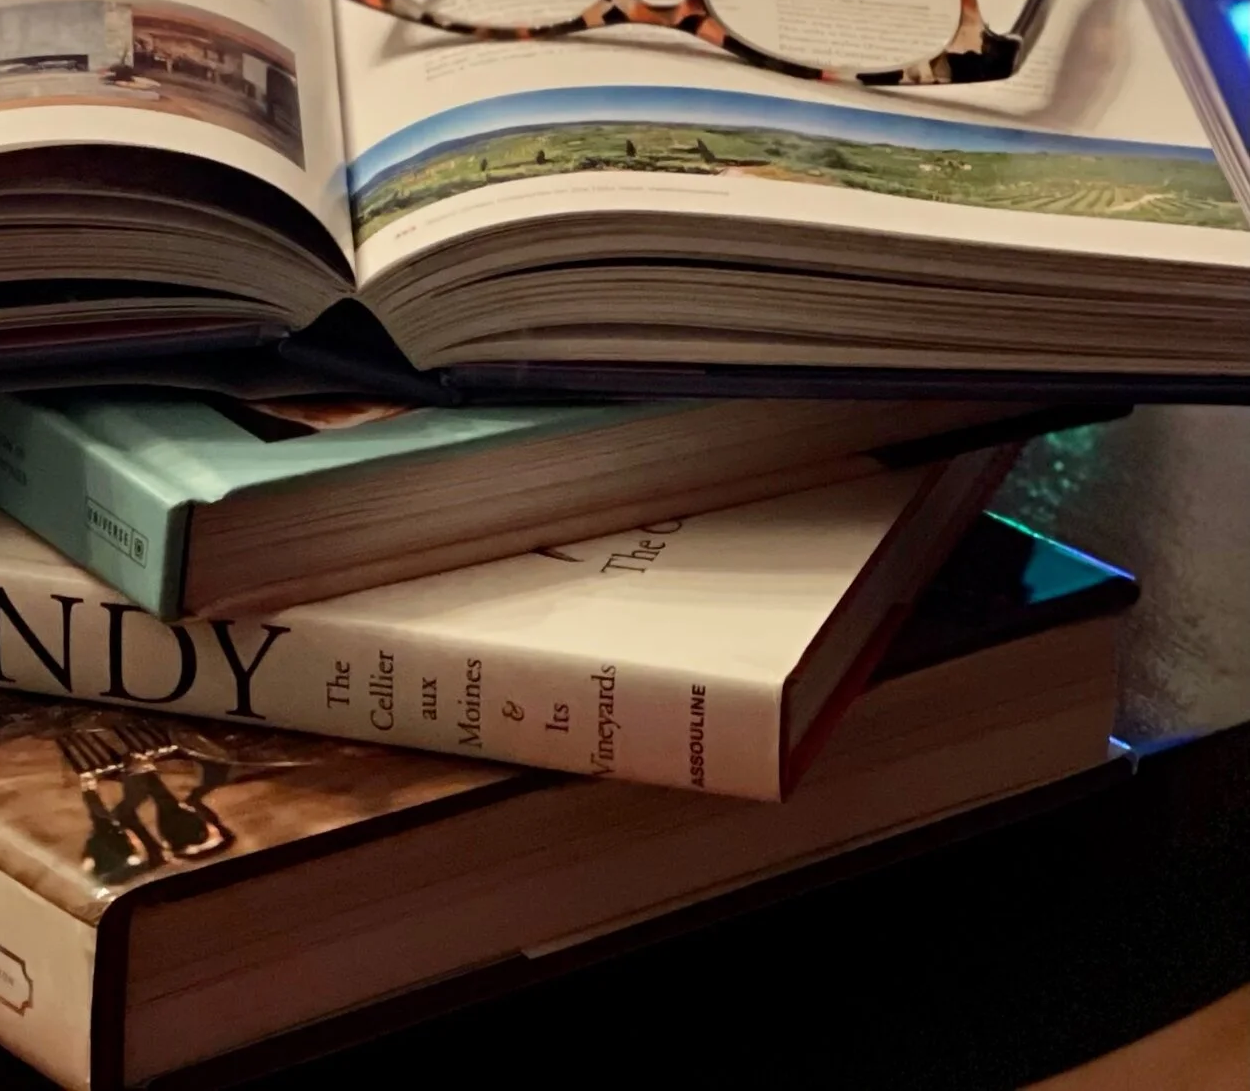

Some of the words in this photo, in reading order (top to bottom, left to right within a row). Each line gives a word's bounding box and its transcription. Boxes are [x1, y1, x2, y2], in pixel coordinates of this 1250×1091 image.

[600, 539, 666, 573] The
[325, 660, 350, 709] The
[369, 650, 395, 731] Cellier
[422, 677, 437, 721] aux
[458, 658, 483, 749] Moines
[502, 700, 525, 722] &
[545, 702, 569, 733] Its
[591, 664, 621, 777] Vineyards
[690, 684, 706, 788] ASSOULINE
